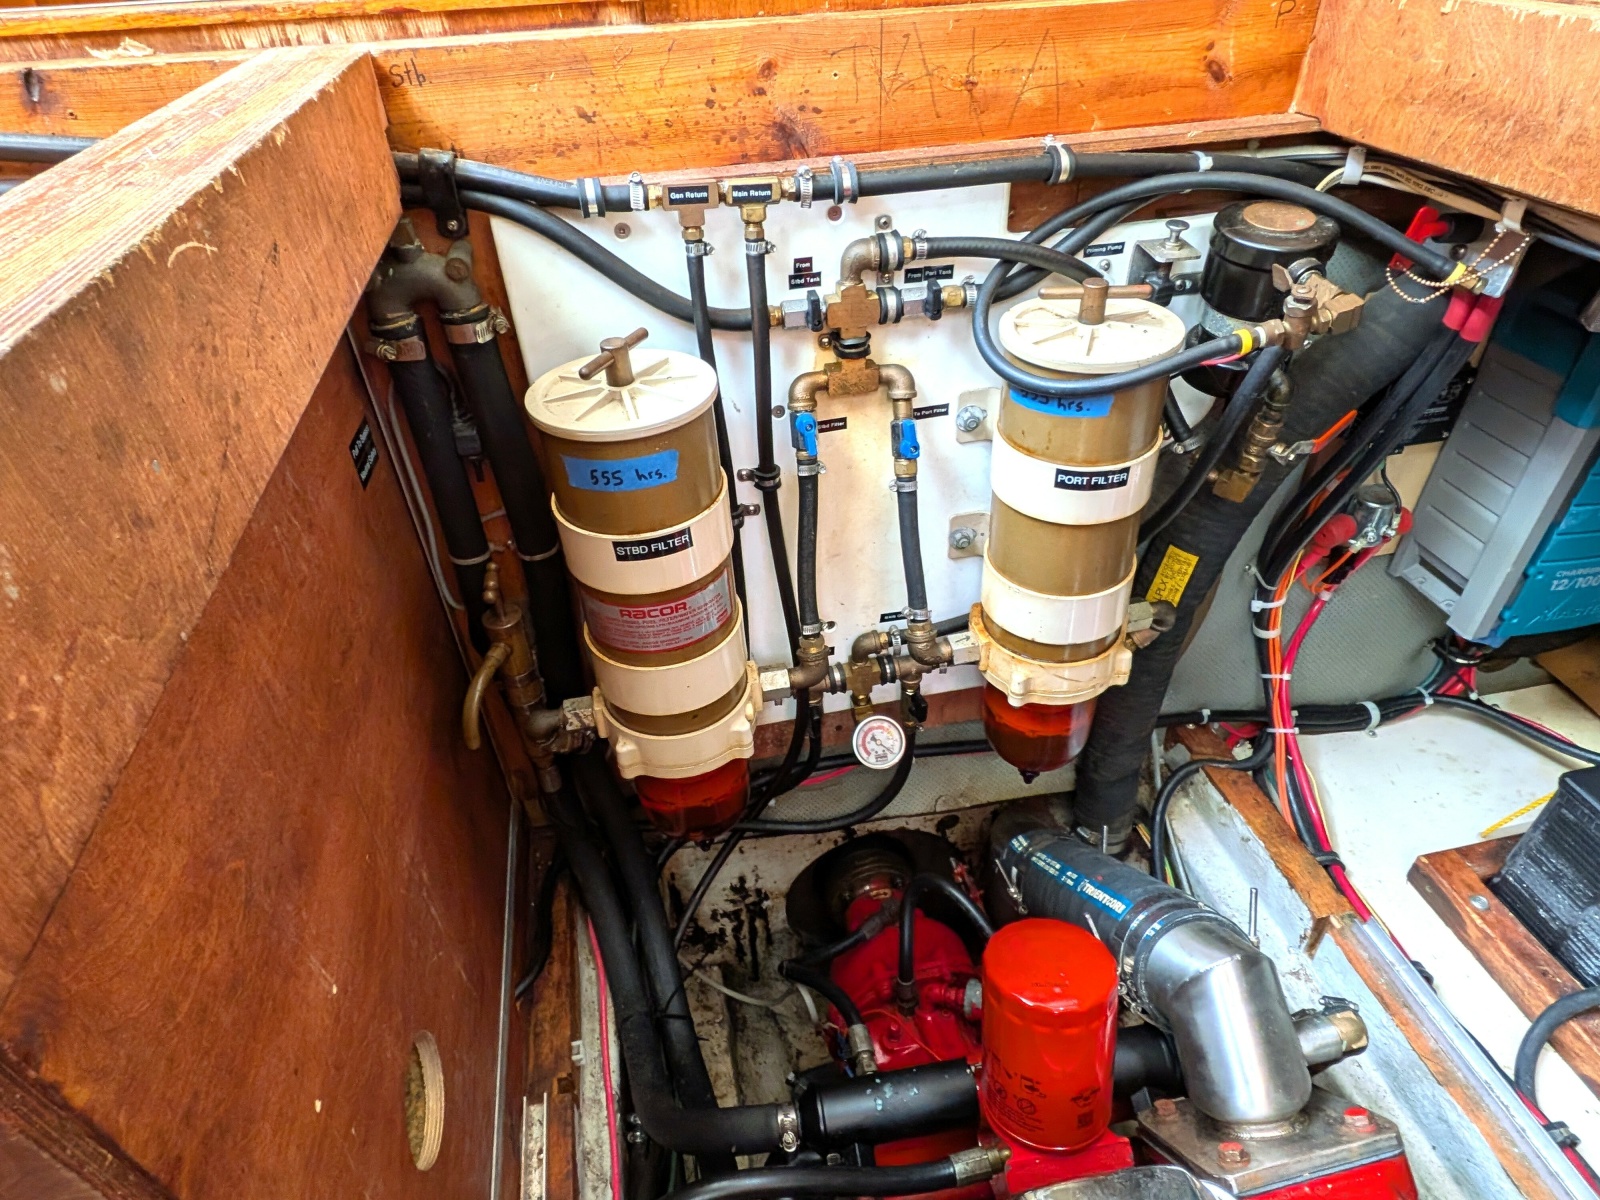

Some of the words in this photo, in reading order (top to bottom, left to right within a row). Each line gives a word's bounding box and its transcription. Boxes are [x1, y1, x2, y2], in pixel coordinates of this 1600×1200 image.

[669, 191, 685, 200] Gen
[685, 190, 708, 199] Return
[732, 190, 749, 198] Main
[749, 189, 772, 197] Return
[589, 469, 625, 487] 555
[635, 466, 667, 481] hrs.
[1057, 474, 1090, 486] PORT
[1091, 472, 1128, 486] FILTER
[616, 545, 649, 556] STBD
[651, 534, 690, 553] FILTER
